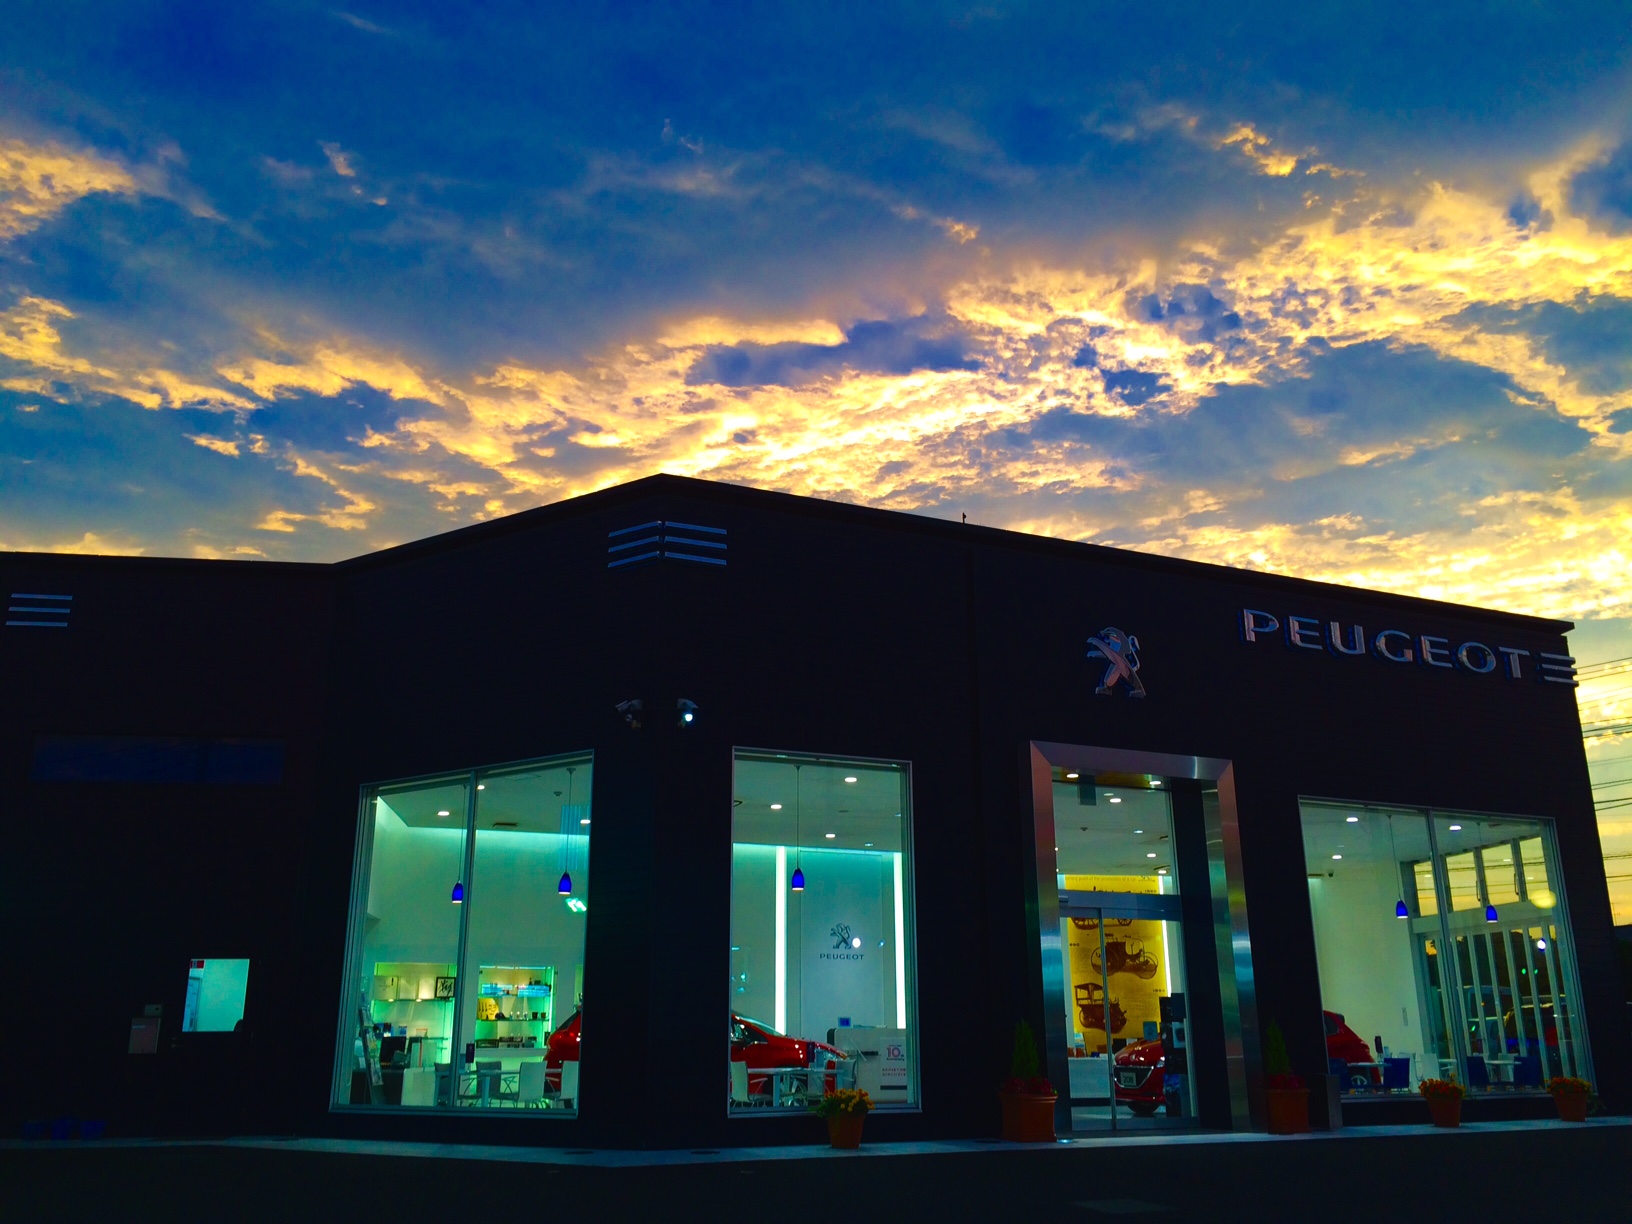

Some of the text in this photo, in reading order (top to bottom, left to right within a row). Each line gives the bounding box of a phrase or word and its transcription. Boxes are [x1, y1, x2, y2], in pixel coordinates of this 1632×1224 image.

[1240, 608, 1530, 679] PEUGEOT
[887, 1047, 901, 1058] 10
[1123, 1076, 1134, 1084] 208
